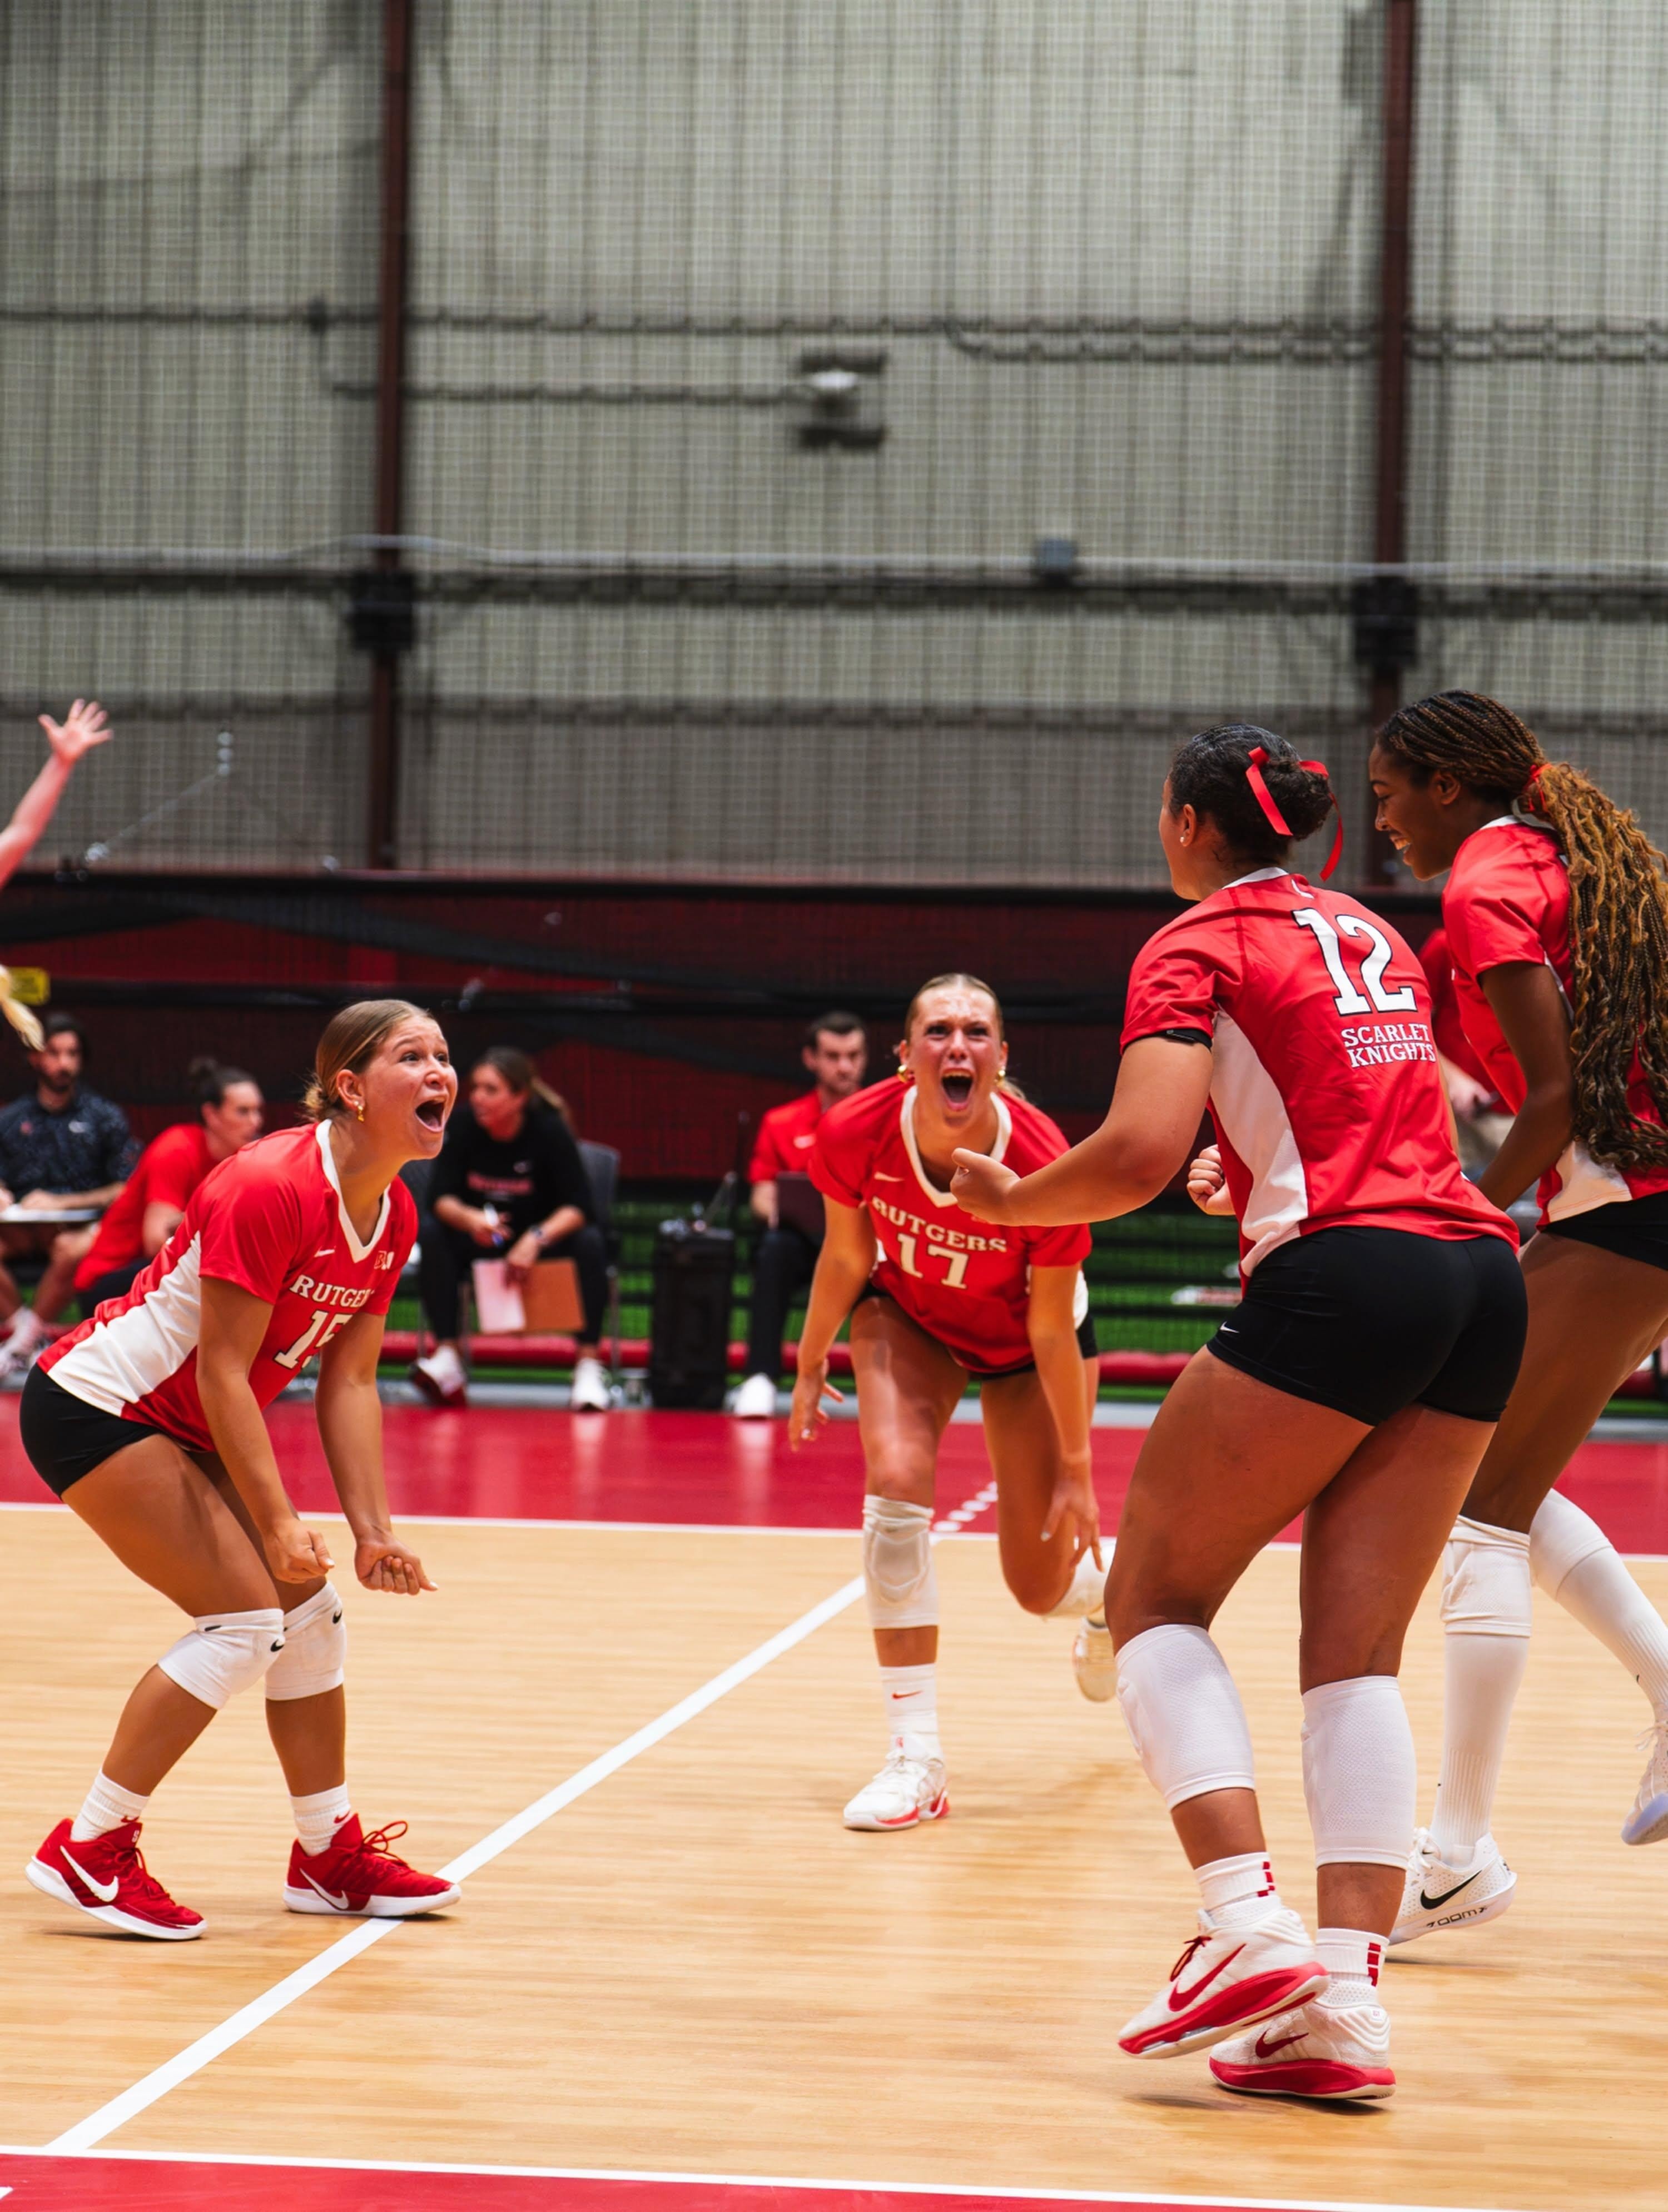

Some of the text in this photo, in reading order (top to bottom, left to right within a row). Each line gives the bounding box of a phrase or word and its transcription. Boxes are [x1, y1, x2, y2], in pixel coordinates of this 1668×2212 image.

[1291, 907, 1418, 1016] 12
[1341, 1023, 1431, 1047] SCARLET
[1347, 1041, 1436, 1068] KNIGHTS
[871, 1196, 1007, 1253] RUTGERS
[896, 1232, 970, 1289] 17
